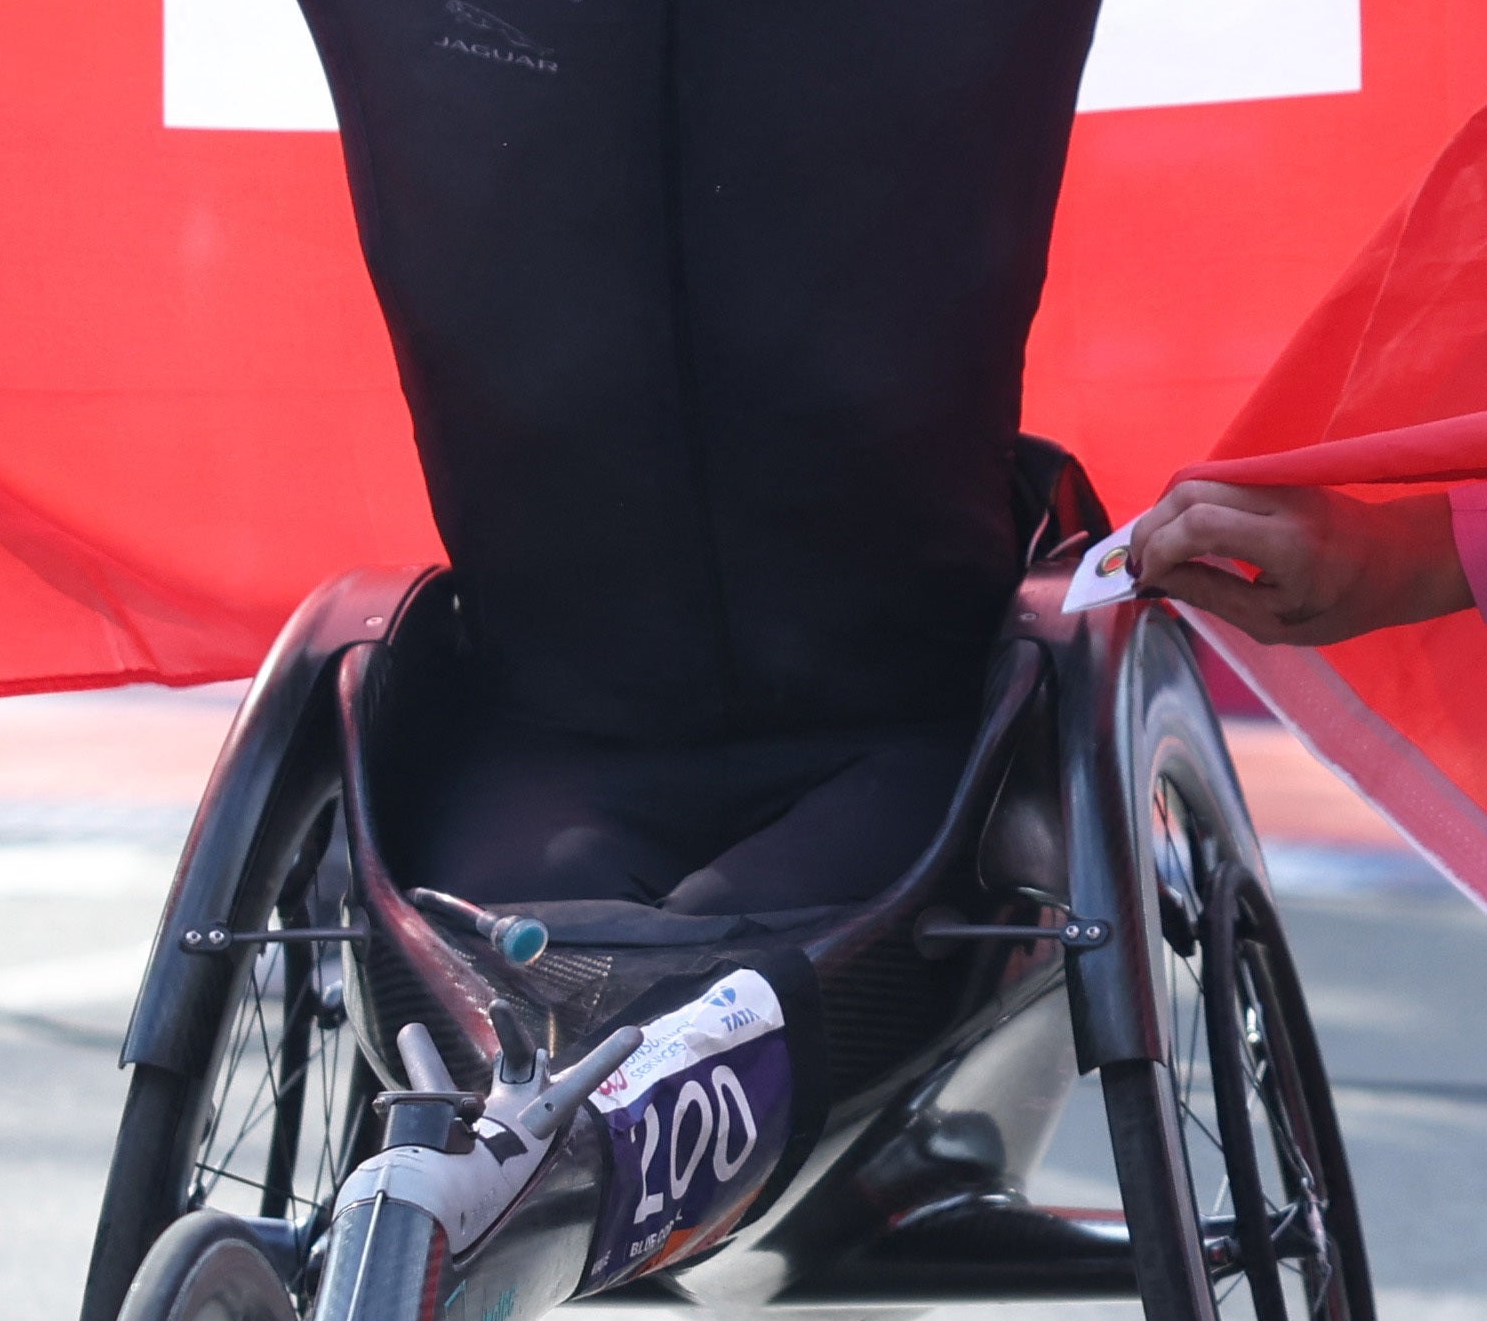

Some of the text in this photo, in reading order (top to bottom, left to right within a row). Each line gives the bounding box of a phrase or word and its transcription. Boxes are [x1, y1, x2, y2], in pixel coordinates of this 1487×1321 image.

[433, 36, 559, 73] JAGUAR
[720, 1007, 762, 1032] TATA
[630, 1065, 757, 1225] 200
